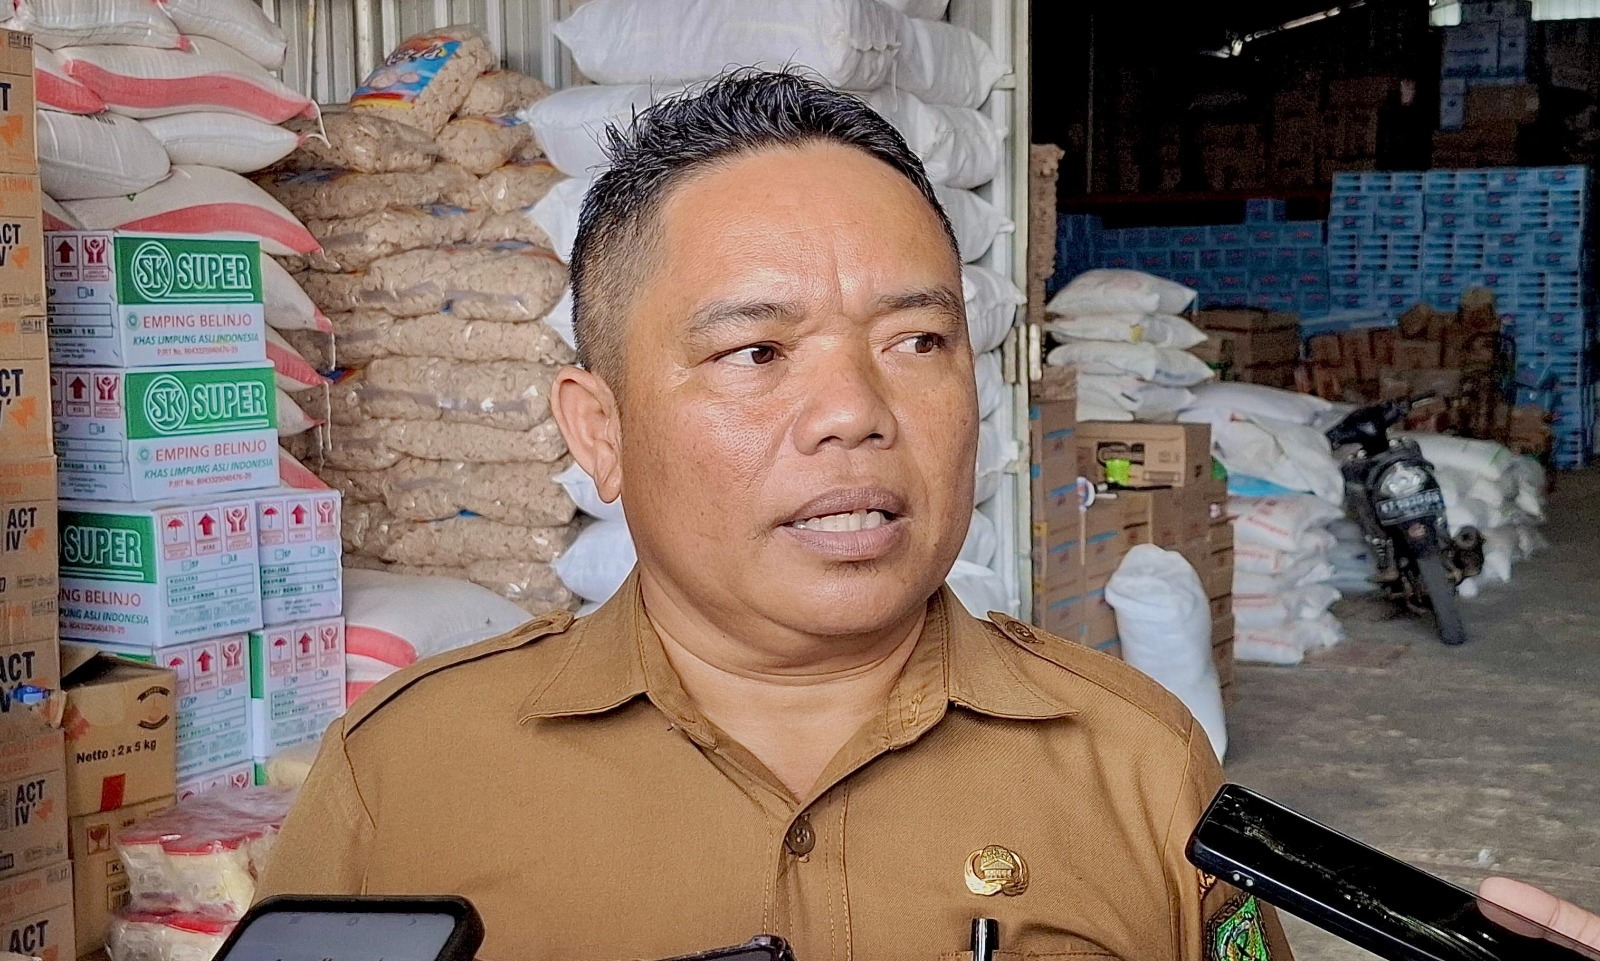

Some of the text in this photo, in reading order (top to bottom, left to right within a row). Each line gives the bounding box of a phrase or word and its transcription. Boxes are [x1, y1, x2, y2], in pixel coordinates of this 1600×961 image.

[0, 223, 21, 245] CT
[137, 252, 252, 290] SK SUPER
[143, 313, 252, 329] EMPING BELINJO
[133, 335, 156, 346] KHAS
[157, 334, 197, 345] LIMPUNG
[216, 332, 259, 343] INDONESIA
[0, 368, 24, 397] CT
[149, 381, 268, 422] SK SUPER
[155, 439, 268, 462] EMPING BELINJO
[144, 458, 274, 480] KHAS LIMPUNG ASLI INDONESIA
[7, 507, 38, 529] ACT
[64, 525, 143, 568] SUPER
[85, 589, 142, 607] BELINJO
[59, 607, 82, 619] PUNG
[102, 611, 150, 625] INDONESIA
[76, 749, 109, 764] Netto
[117, 744, 125, 756] 2
[126, 745, 132, 755] x
[134, 741, 141, 752] 5
[144, 739, 157, 751] kg
[15, 779, 45, 805] ACT
[9, 919, 49, 954] ACT
